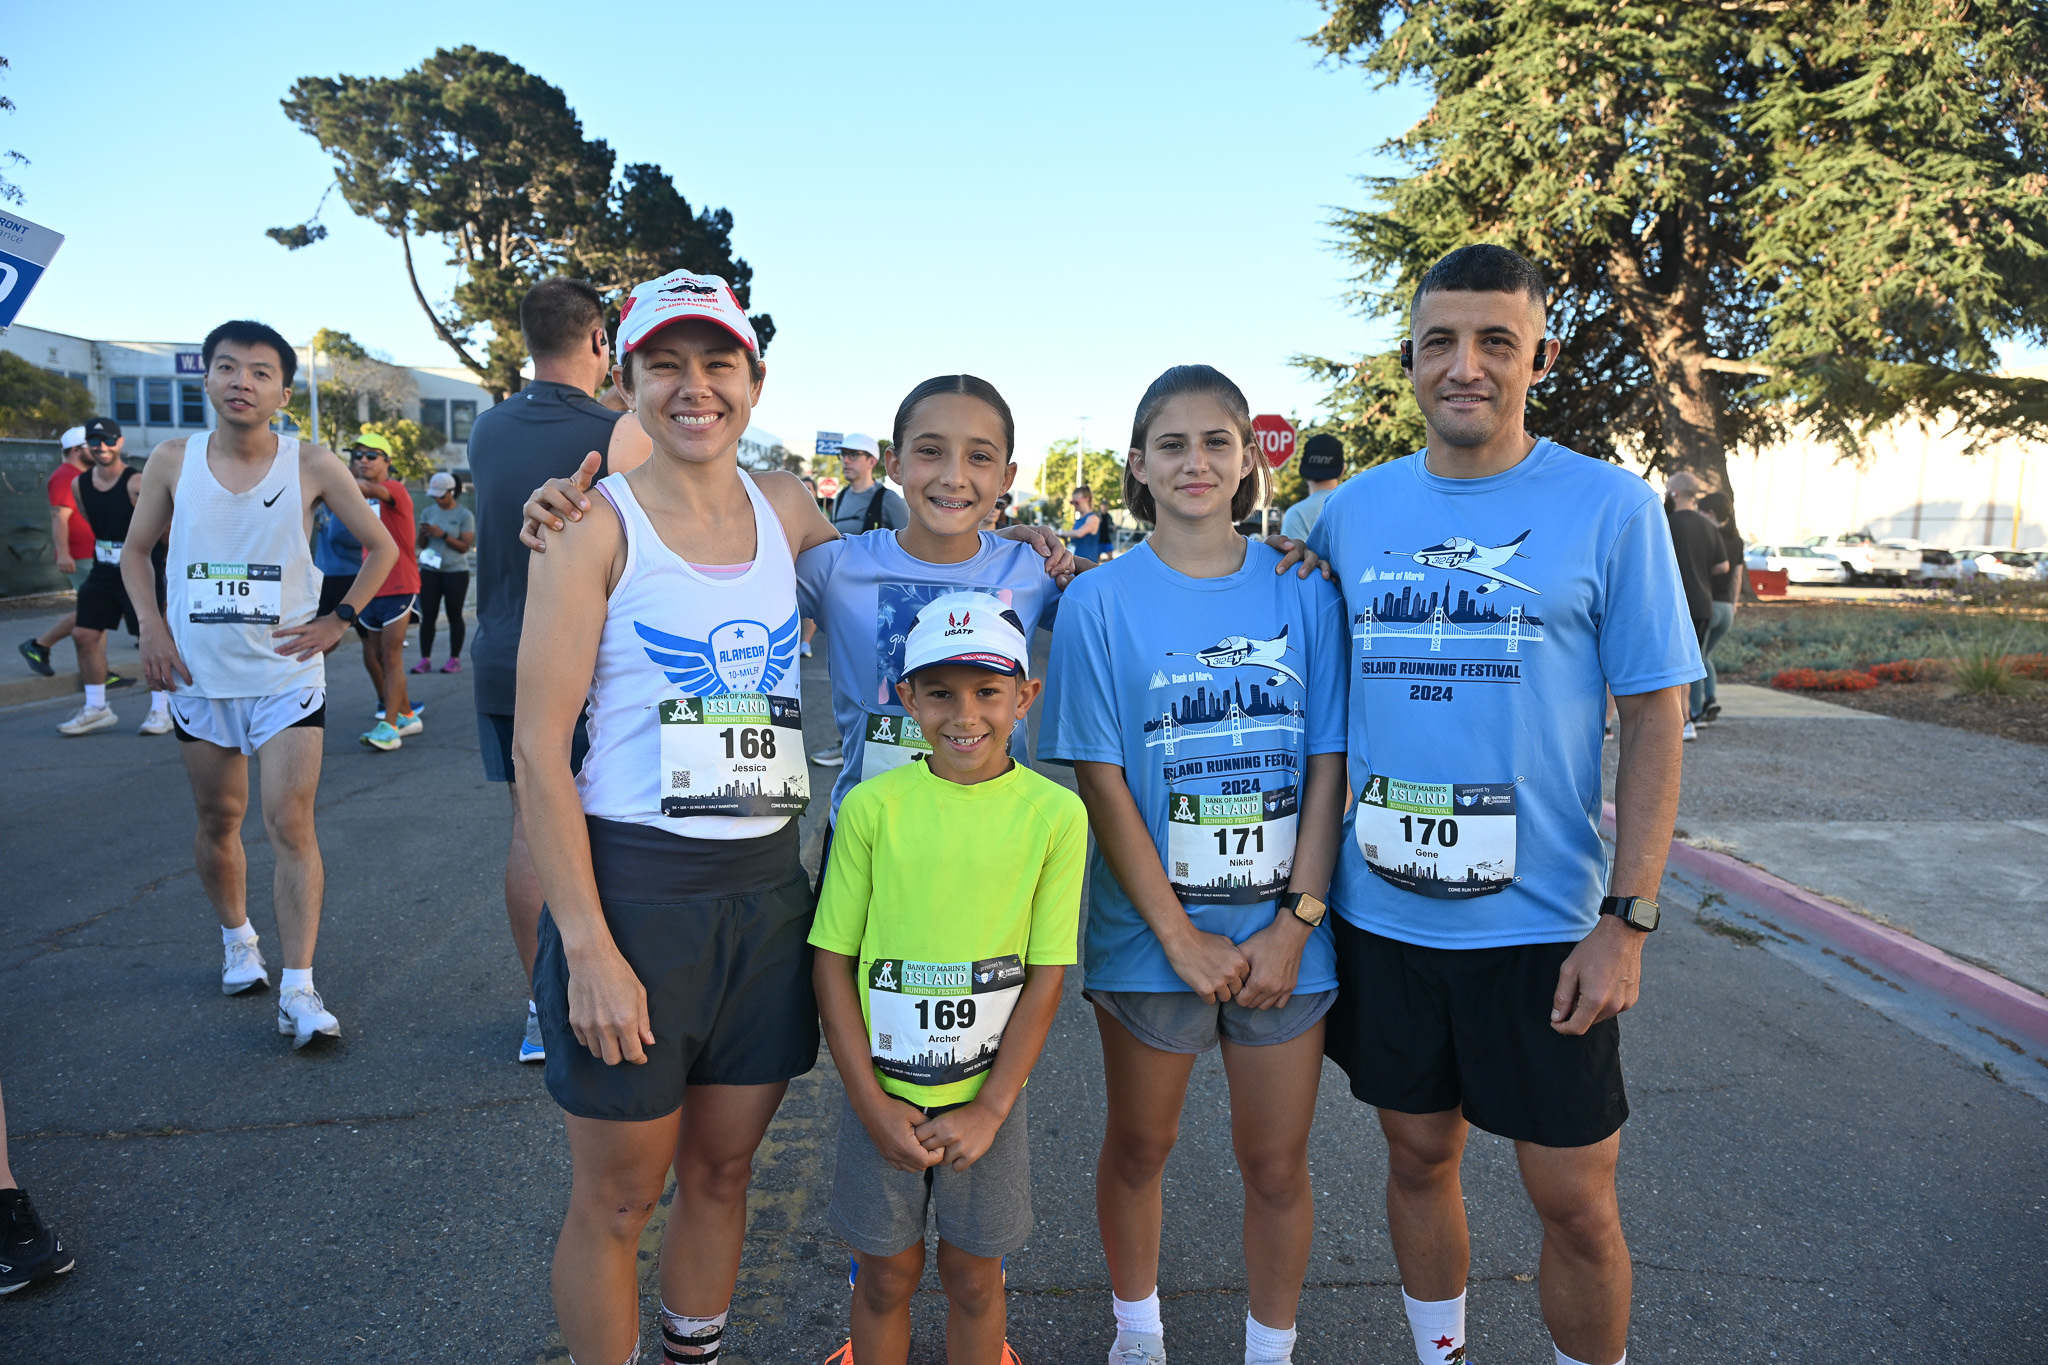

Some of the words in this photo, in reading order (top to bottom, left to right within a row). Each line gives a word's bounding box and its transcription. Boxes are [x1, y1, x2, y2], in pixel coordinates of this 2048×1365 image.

[0, 217, 29, 234] RONT
[0, 229, 24, 244] ance
[1256, 430, 1292, 452] TOP
[210, 567, 245, 575] ISLAND
[1380, 571, 1395, 580] Bank
[1396, 571, 1403, 580] of
[1404, 571, 1425, 581] Marin
[216, 581, 250, 596] 116
[944, 628, 974, 636] USATF
[720, 645, 764, 663] ALAMEDA
[1362, 662, 1396, 674] ISLAND
[1400, 662, 1457, 676] RUNNING
[1460, 664, 1521, 678] FESTIVAL
[1172, 672, 1188, 684] Bank
[1188, 672, 1194, 682] of
[1410, 684, 1454, 702] 2024
[707, 700, 766, 713] ISLAND
[719, 728, 776, 759] 168
[902, 740, 932, 749] RUNNING
[732, 764, 767, 773] Jessica
[1163, 762, 1203, 779] ISLAND
[1206, 756, 1261, 774] RUNNING
[1221, 778, 1261, 795] 2024
[1393, 781, 1408, 789] BANK
[1391, 788, 1448, 805] ISLAND
[1204, 803, 1259, 815] ISLAND
[1390, 802, 1418, 812] RUNNING
[1234, 816, 1261, 824] FESTIVAL
[1400, 815, 1459, 847] 170
[1214, 825, 1264, 855] 171
[1415, 848, 1439, 859] Gene
[1229, 859, 1254, 867] Nikita
[936, 964, 966, 972] MARIN'S
[906, 971, 967, 985] ISLAND
[905, 987, 936, 995] RUNNING
[937, 987, 969, 995] FESTIVAL
[914, 999, 976, 1030] 169
[928, 1035, 961, 1043] Archer
